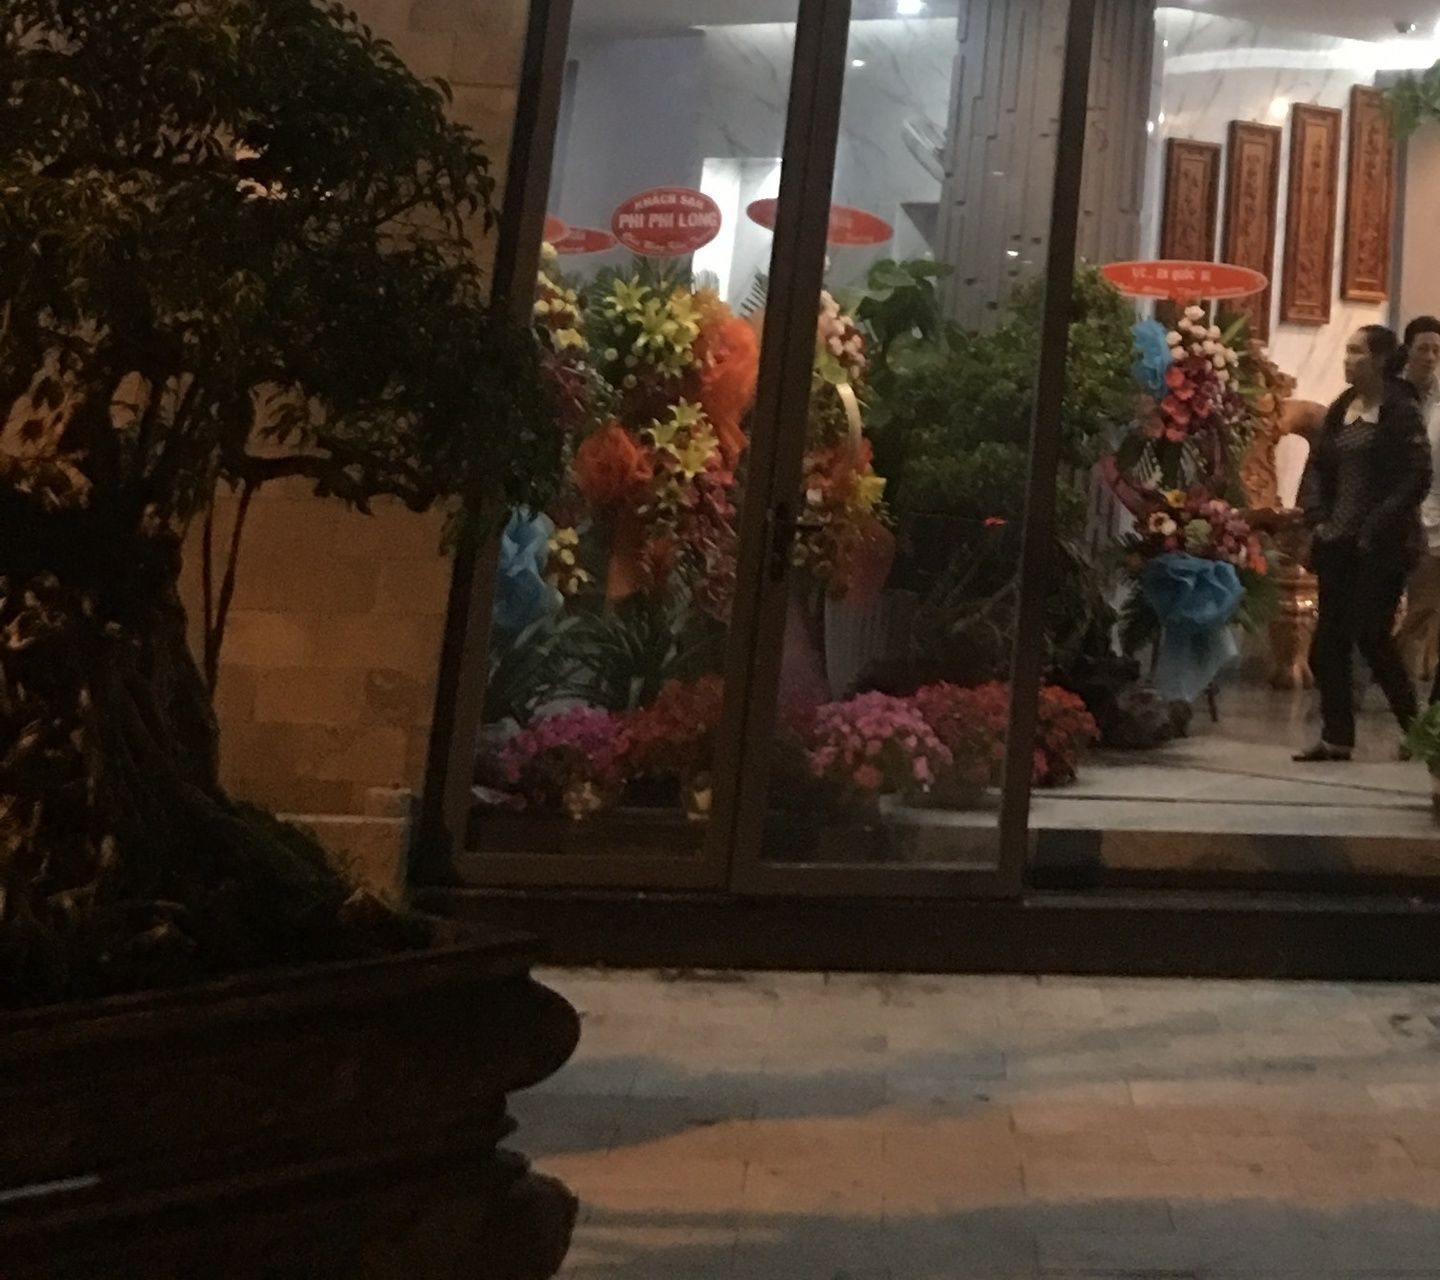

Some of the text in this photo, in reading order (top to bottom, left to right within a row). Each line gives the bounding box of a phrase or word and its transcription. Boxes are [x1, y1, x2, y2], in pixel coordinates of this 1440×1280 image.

[619, 212, 719, 229] PHI PHI LONG
